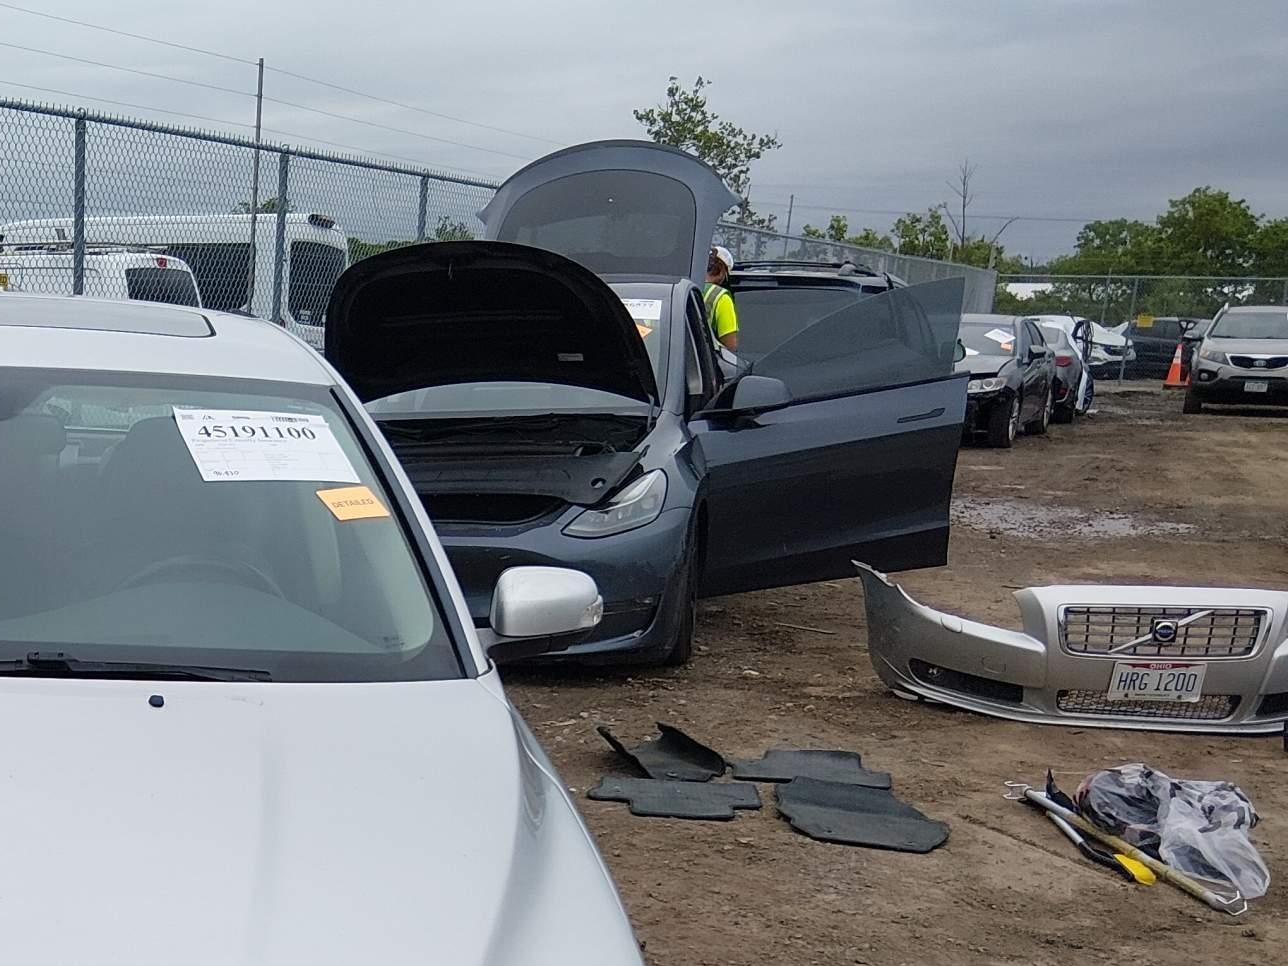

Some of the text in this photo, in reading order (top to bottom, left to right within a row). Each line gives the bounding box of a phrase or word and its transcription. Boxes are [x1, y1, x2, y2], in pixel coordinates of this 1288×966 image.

[198, 425, 316, 441] 45191100
[331, 498, 374, 508] DETAILED
[1149, 663, 1172, 671] OHIO
[1116, 672, 1198, 693] HRG 1200
